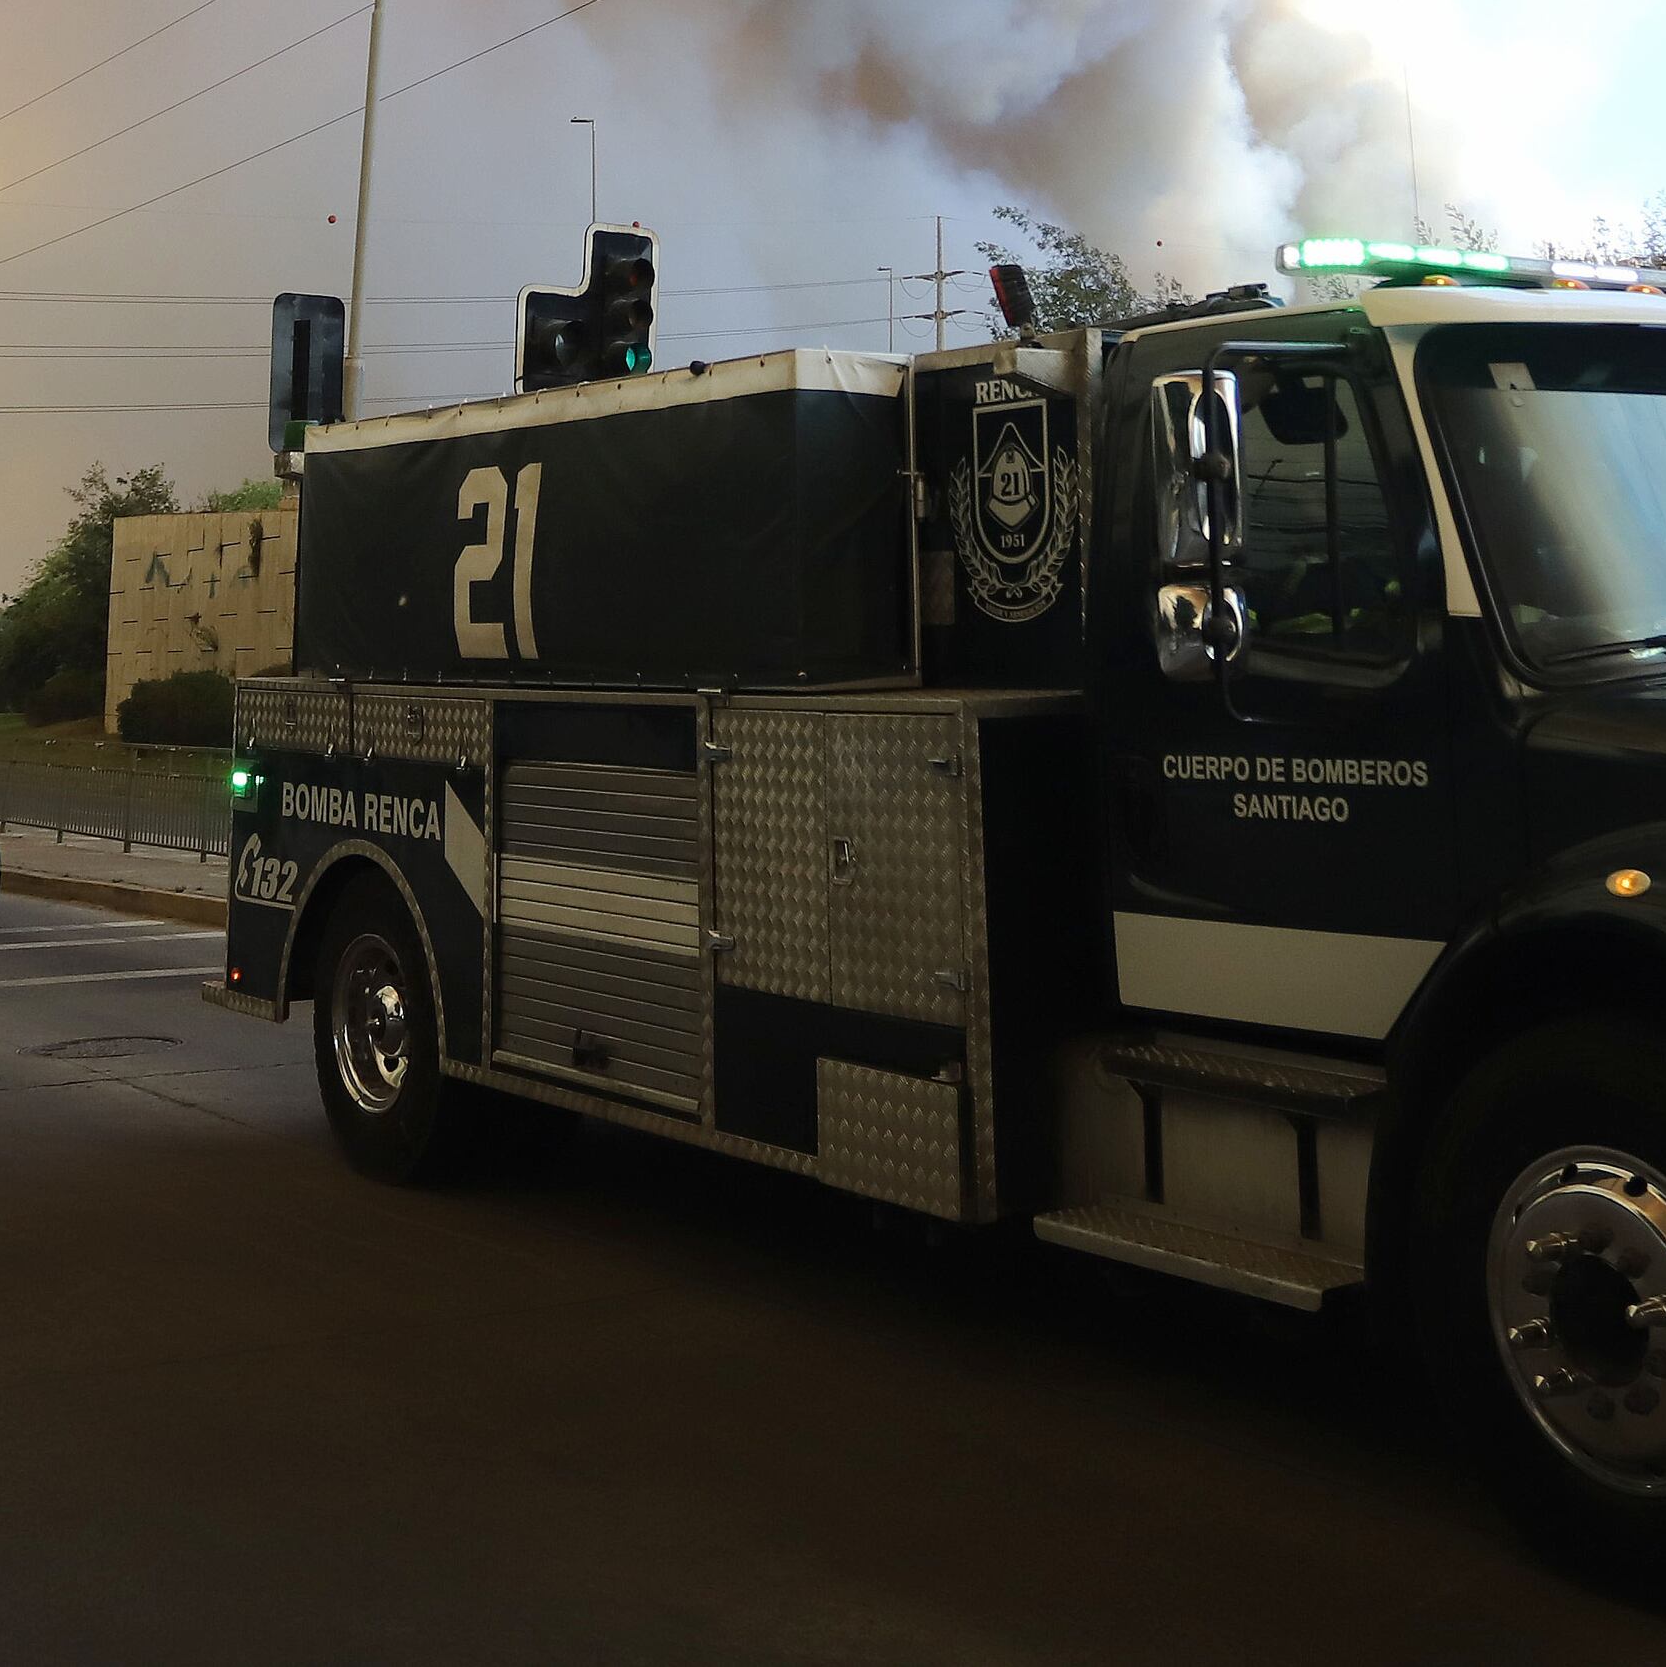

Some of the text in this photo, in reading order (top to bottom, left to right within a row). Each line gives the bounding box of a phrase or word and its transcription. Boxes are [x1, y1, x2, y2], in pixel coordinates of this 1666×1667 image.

[975, 379, 1040, 404] RENC
[1001, 472, 1019, 496] 21
[1000, 534, 1025, 548] 1951
[454, 462, 542, 659] 21
[1163, 755, 1429, 786] CUERPO DE BOMBEROS
[283, 782, 441, 841] BOMBA RENCA
[1233, 793, 1349, 823] SANTIAGO
[252, 857, 298, 903] 132
